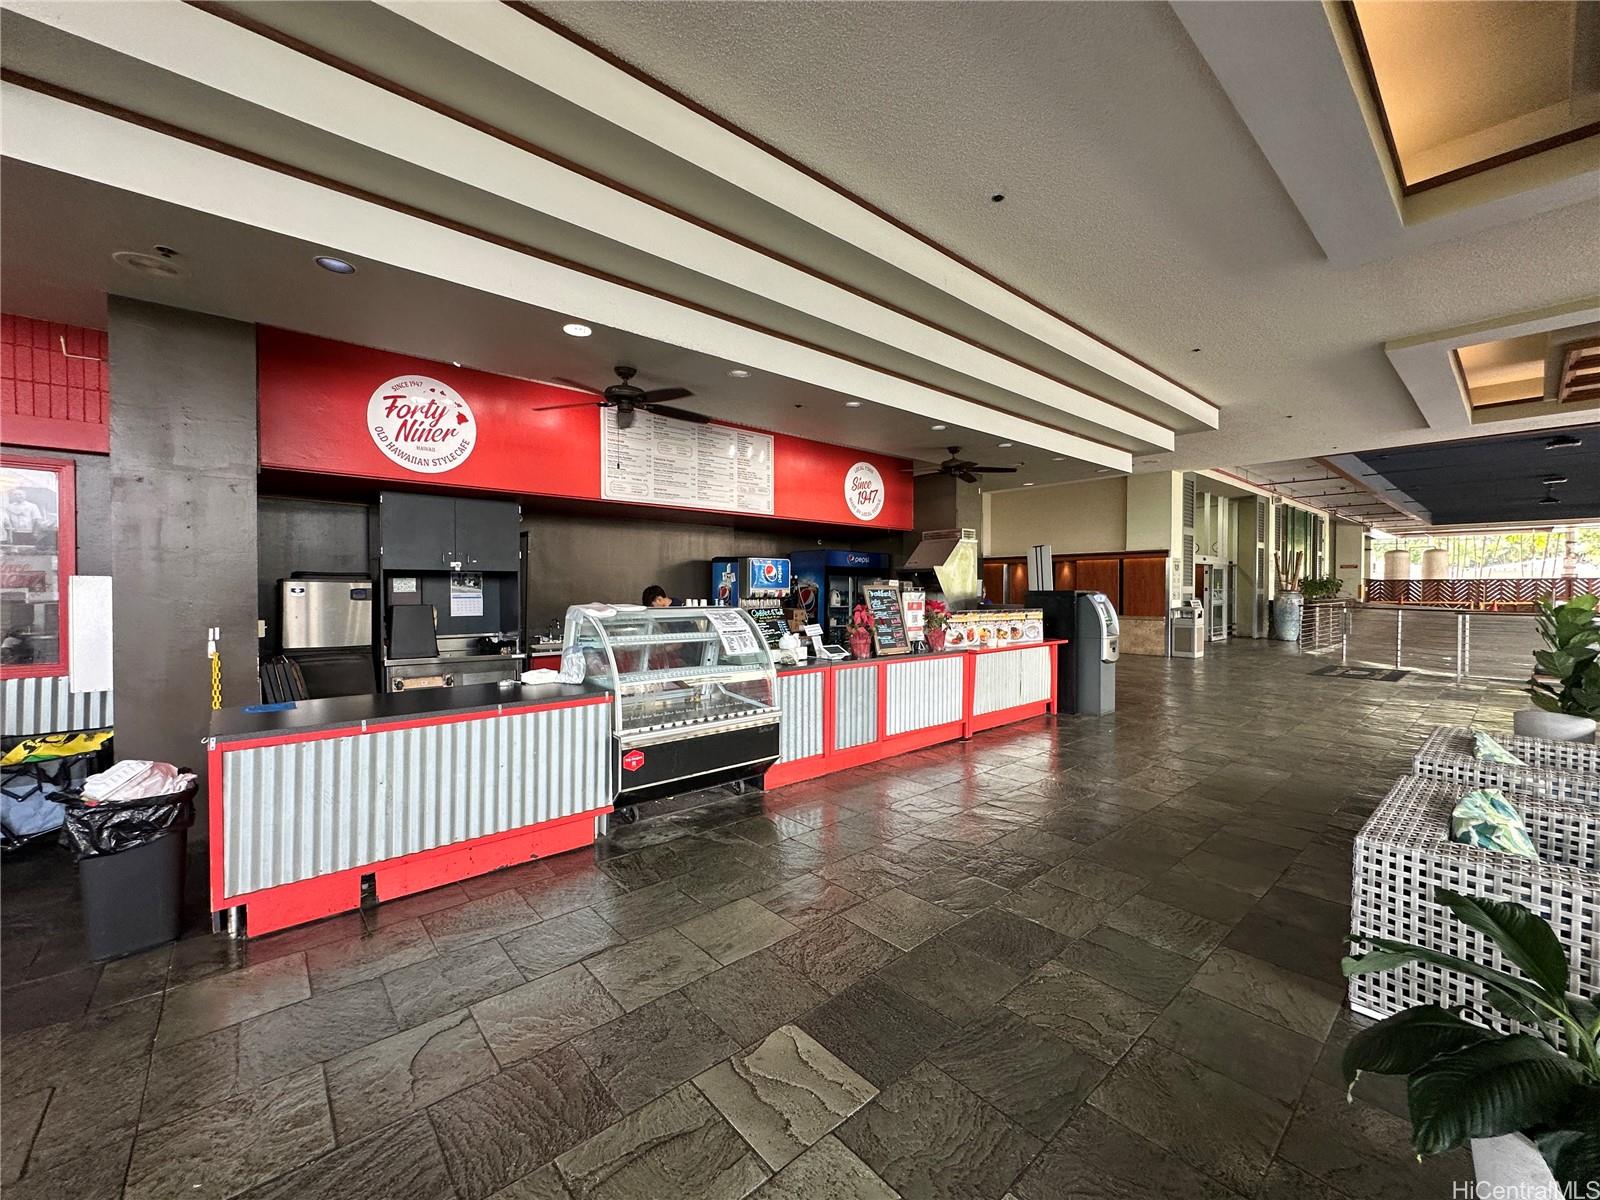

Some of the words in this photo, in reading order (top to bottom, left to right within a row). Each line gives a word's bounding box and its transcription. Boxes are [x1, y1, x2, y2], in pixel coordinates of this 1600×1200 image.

[391, 381, 409, 392] SINCE
[409, 380, 423, 388] 1947
[383, 395, 450, 428] Forty
[394, 419, 460, 443] Niner
[374, 426, 389, 443] OLD
[386, 441, 430, 467] HAWAIIAN
[432, 452, 456, 467] STYLE
[455, 438, 471, 457] CAFE
[851, 476, 872, 492] Since
[857, 489, 879, 505] 1947
